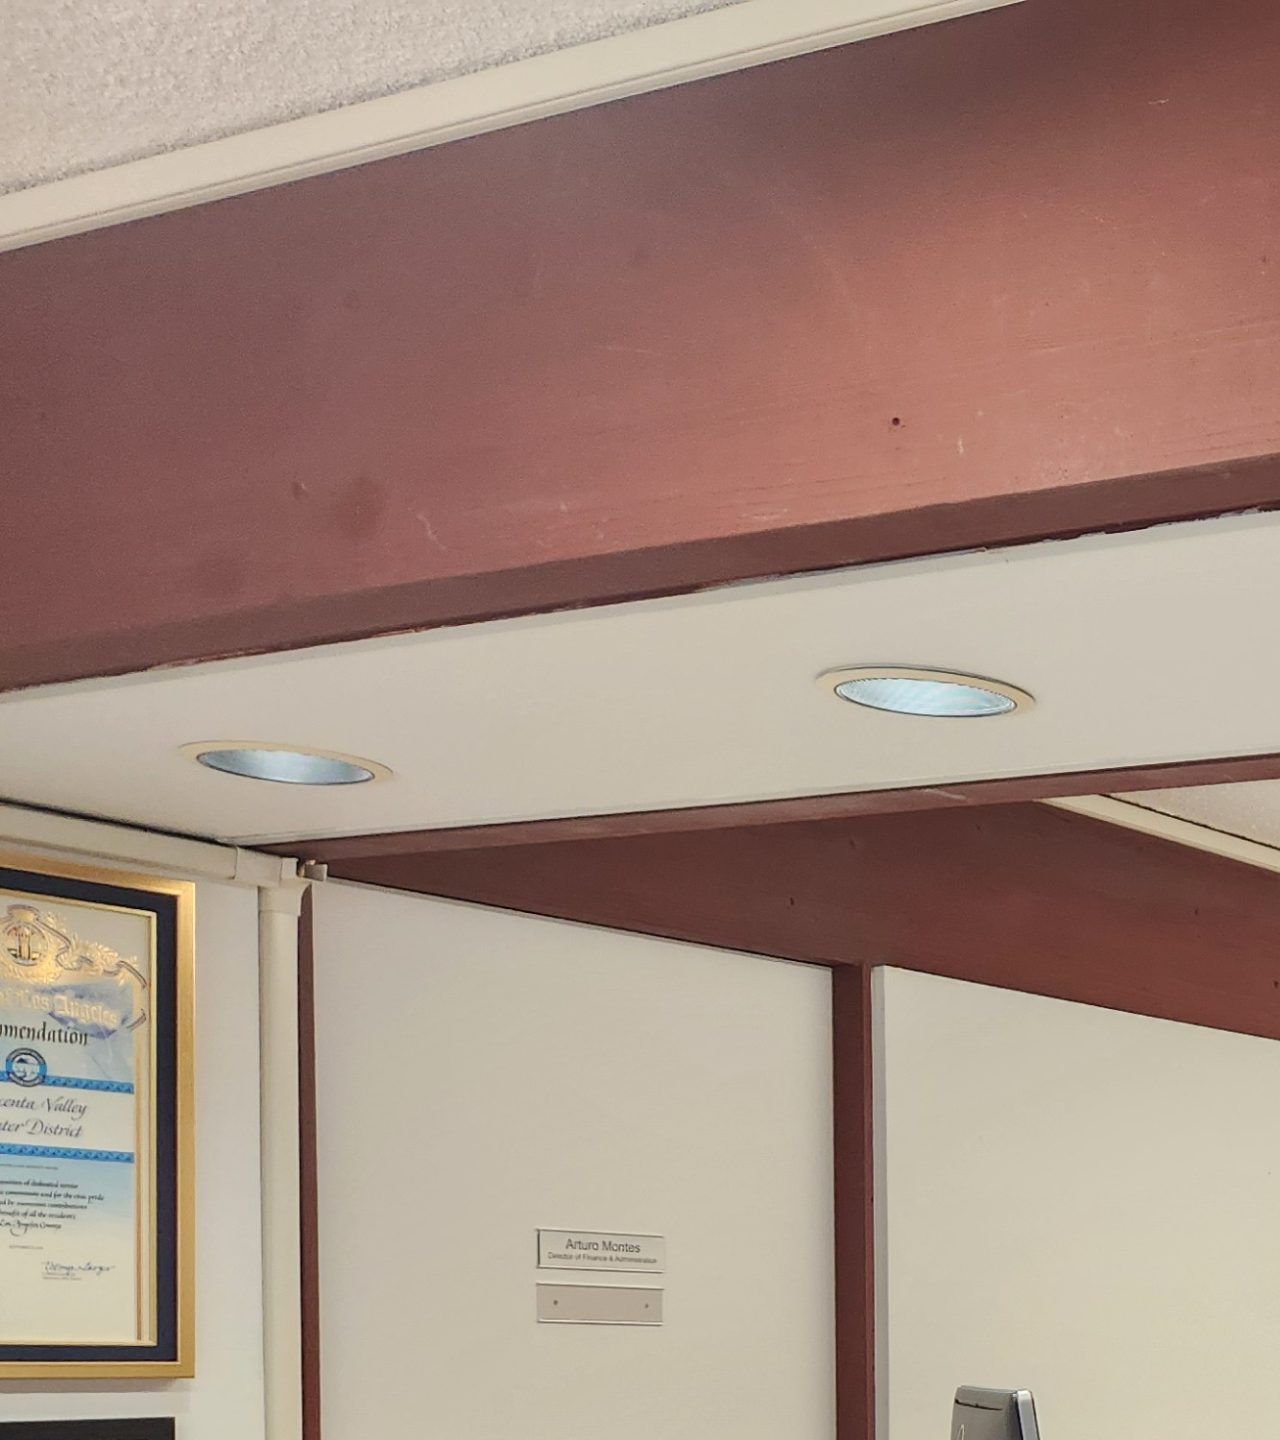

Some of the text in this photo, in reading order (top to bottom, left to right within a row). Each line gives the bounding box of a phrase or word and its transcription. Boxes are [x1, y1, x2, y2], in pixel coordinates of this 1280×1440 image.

[54, 995, 118, 1031] Angeles
[43, 1096, 87, 1120] Valley
[26, 1119, 82, 1138] District
[565, 1238, 641, 1253] Arturo Montes
